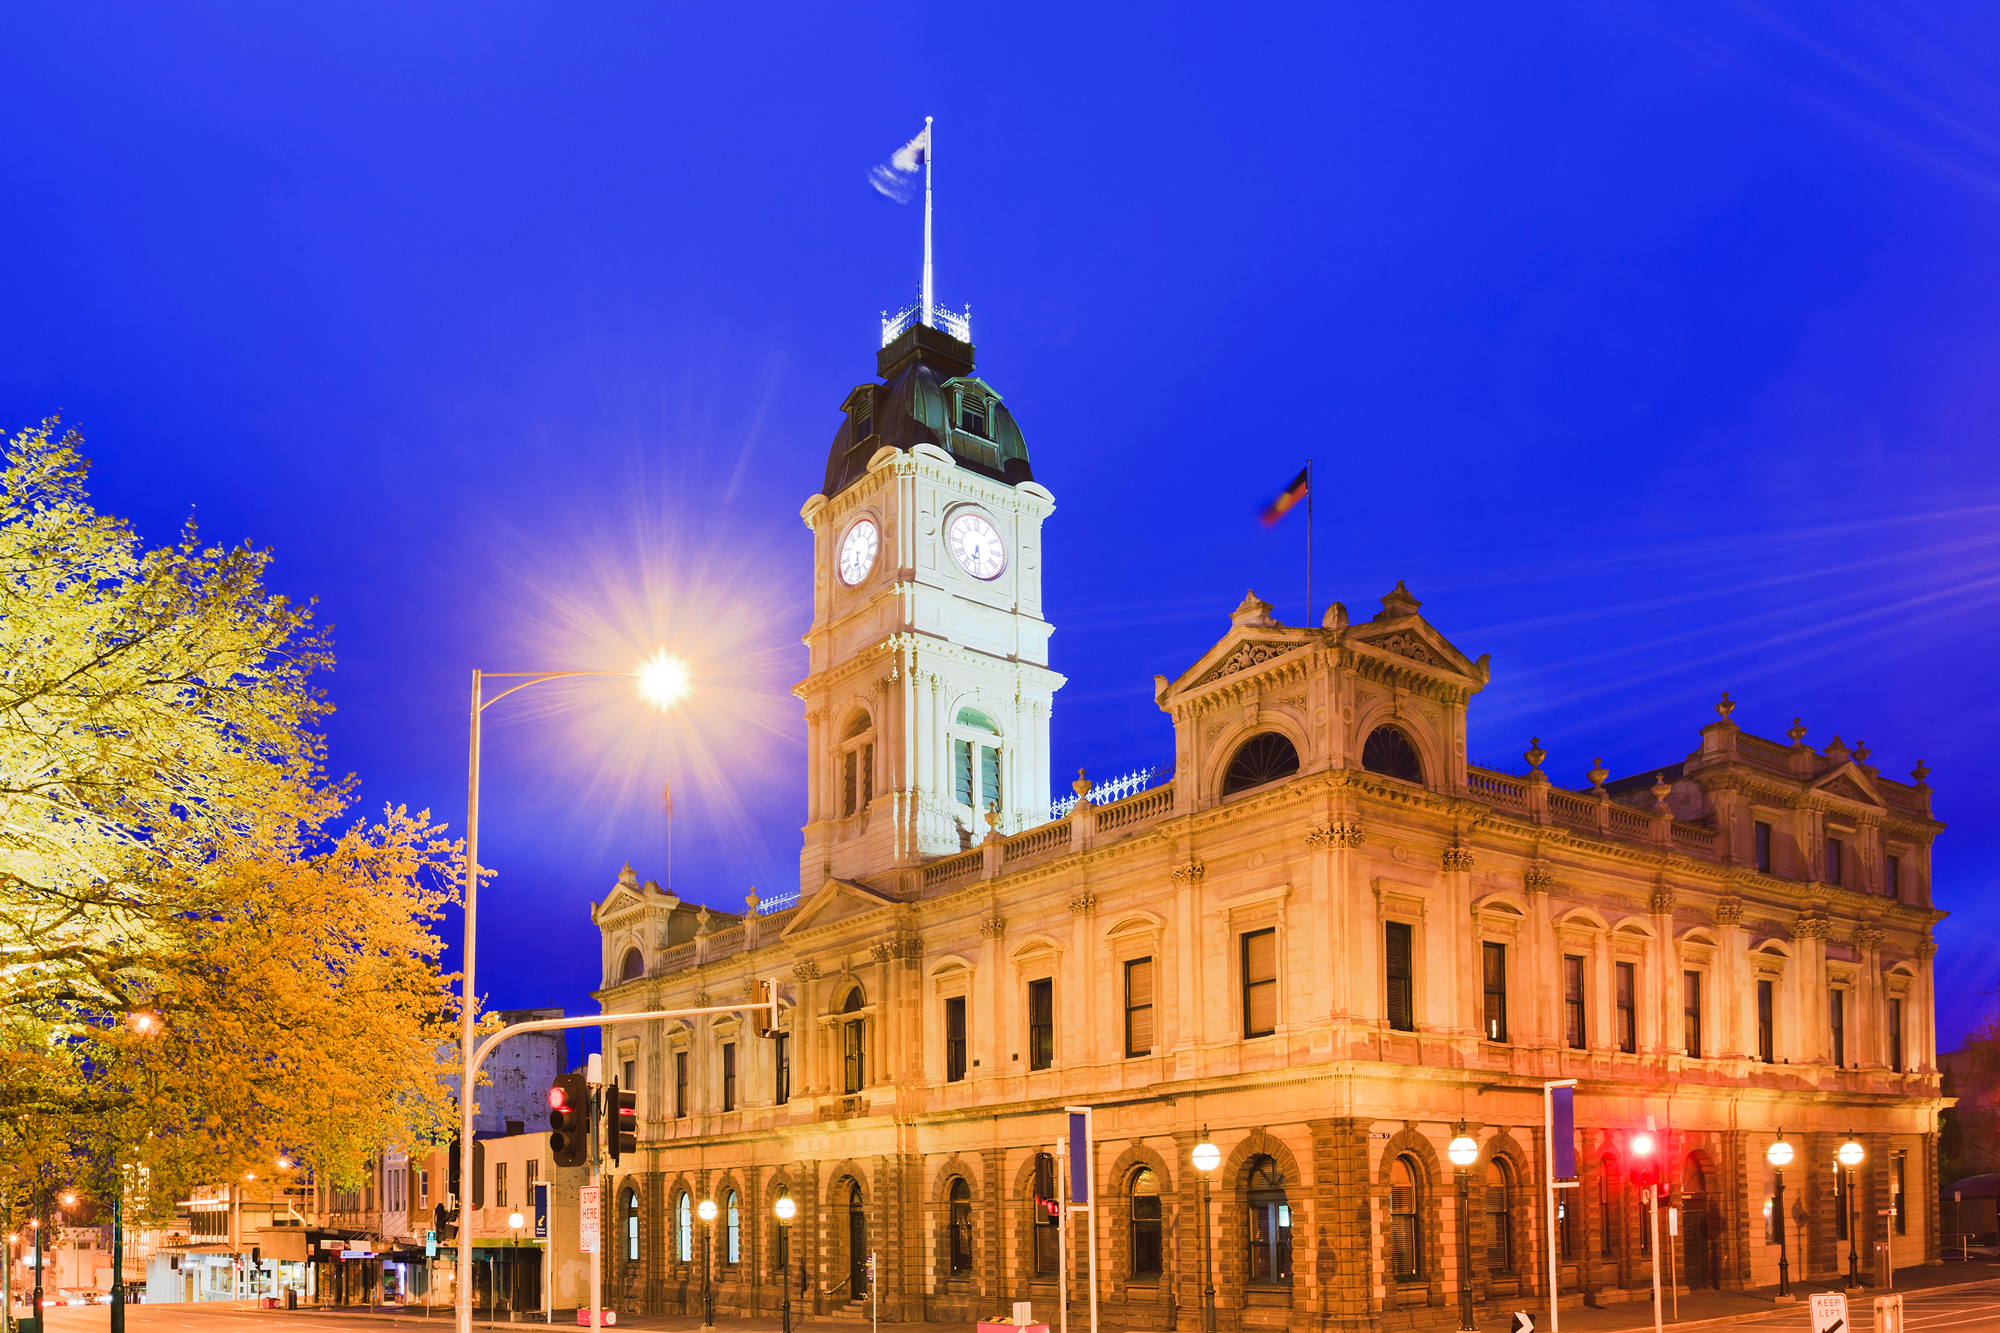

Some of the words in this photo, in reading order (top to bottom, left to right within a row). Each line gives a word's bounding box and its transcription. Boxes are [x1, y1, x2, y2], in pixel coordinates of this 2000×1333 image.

[583, 1192, 597, 1203] STOP
[583, 1208, 597, 1219] HERE
[582, 1223, 589, 1233] ON
[589, 1223, 598, 1233] RED
[1817, 1299, 1840, 1307] KEEP
[1819, 1309, 1840, 1317] LEFT
